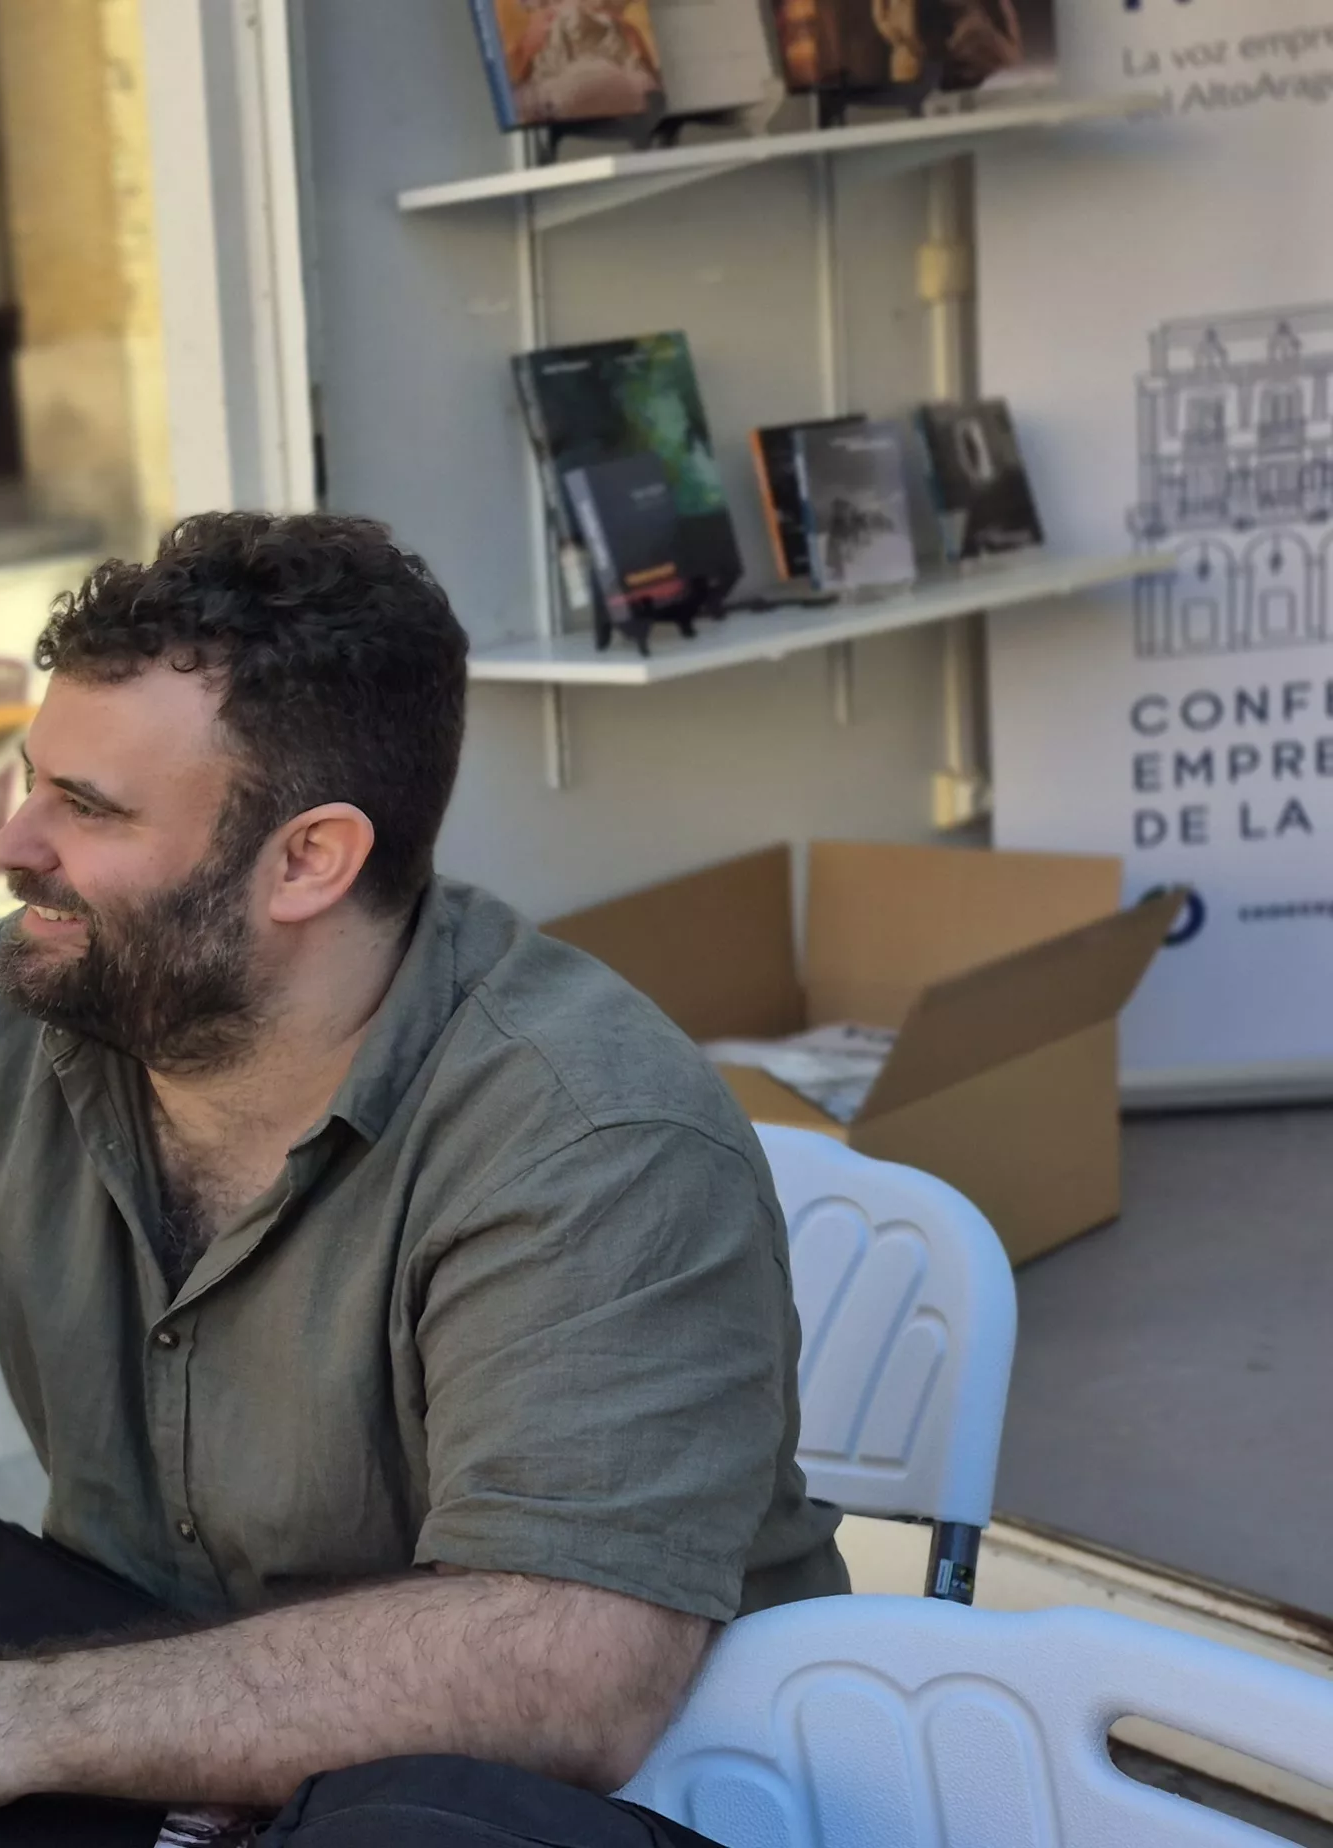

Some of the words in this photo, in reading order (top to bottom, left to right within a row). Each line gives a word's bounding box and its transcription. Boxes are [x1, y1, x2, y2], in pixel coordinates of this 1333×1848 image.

[1122, 46, 1161, 76] La
[1134, 804, 1210, 850] DE
[1240, 797, 1314, 842] LA
